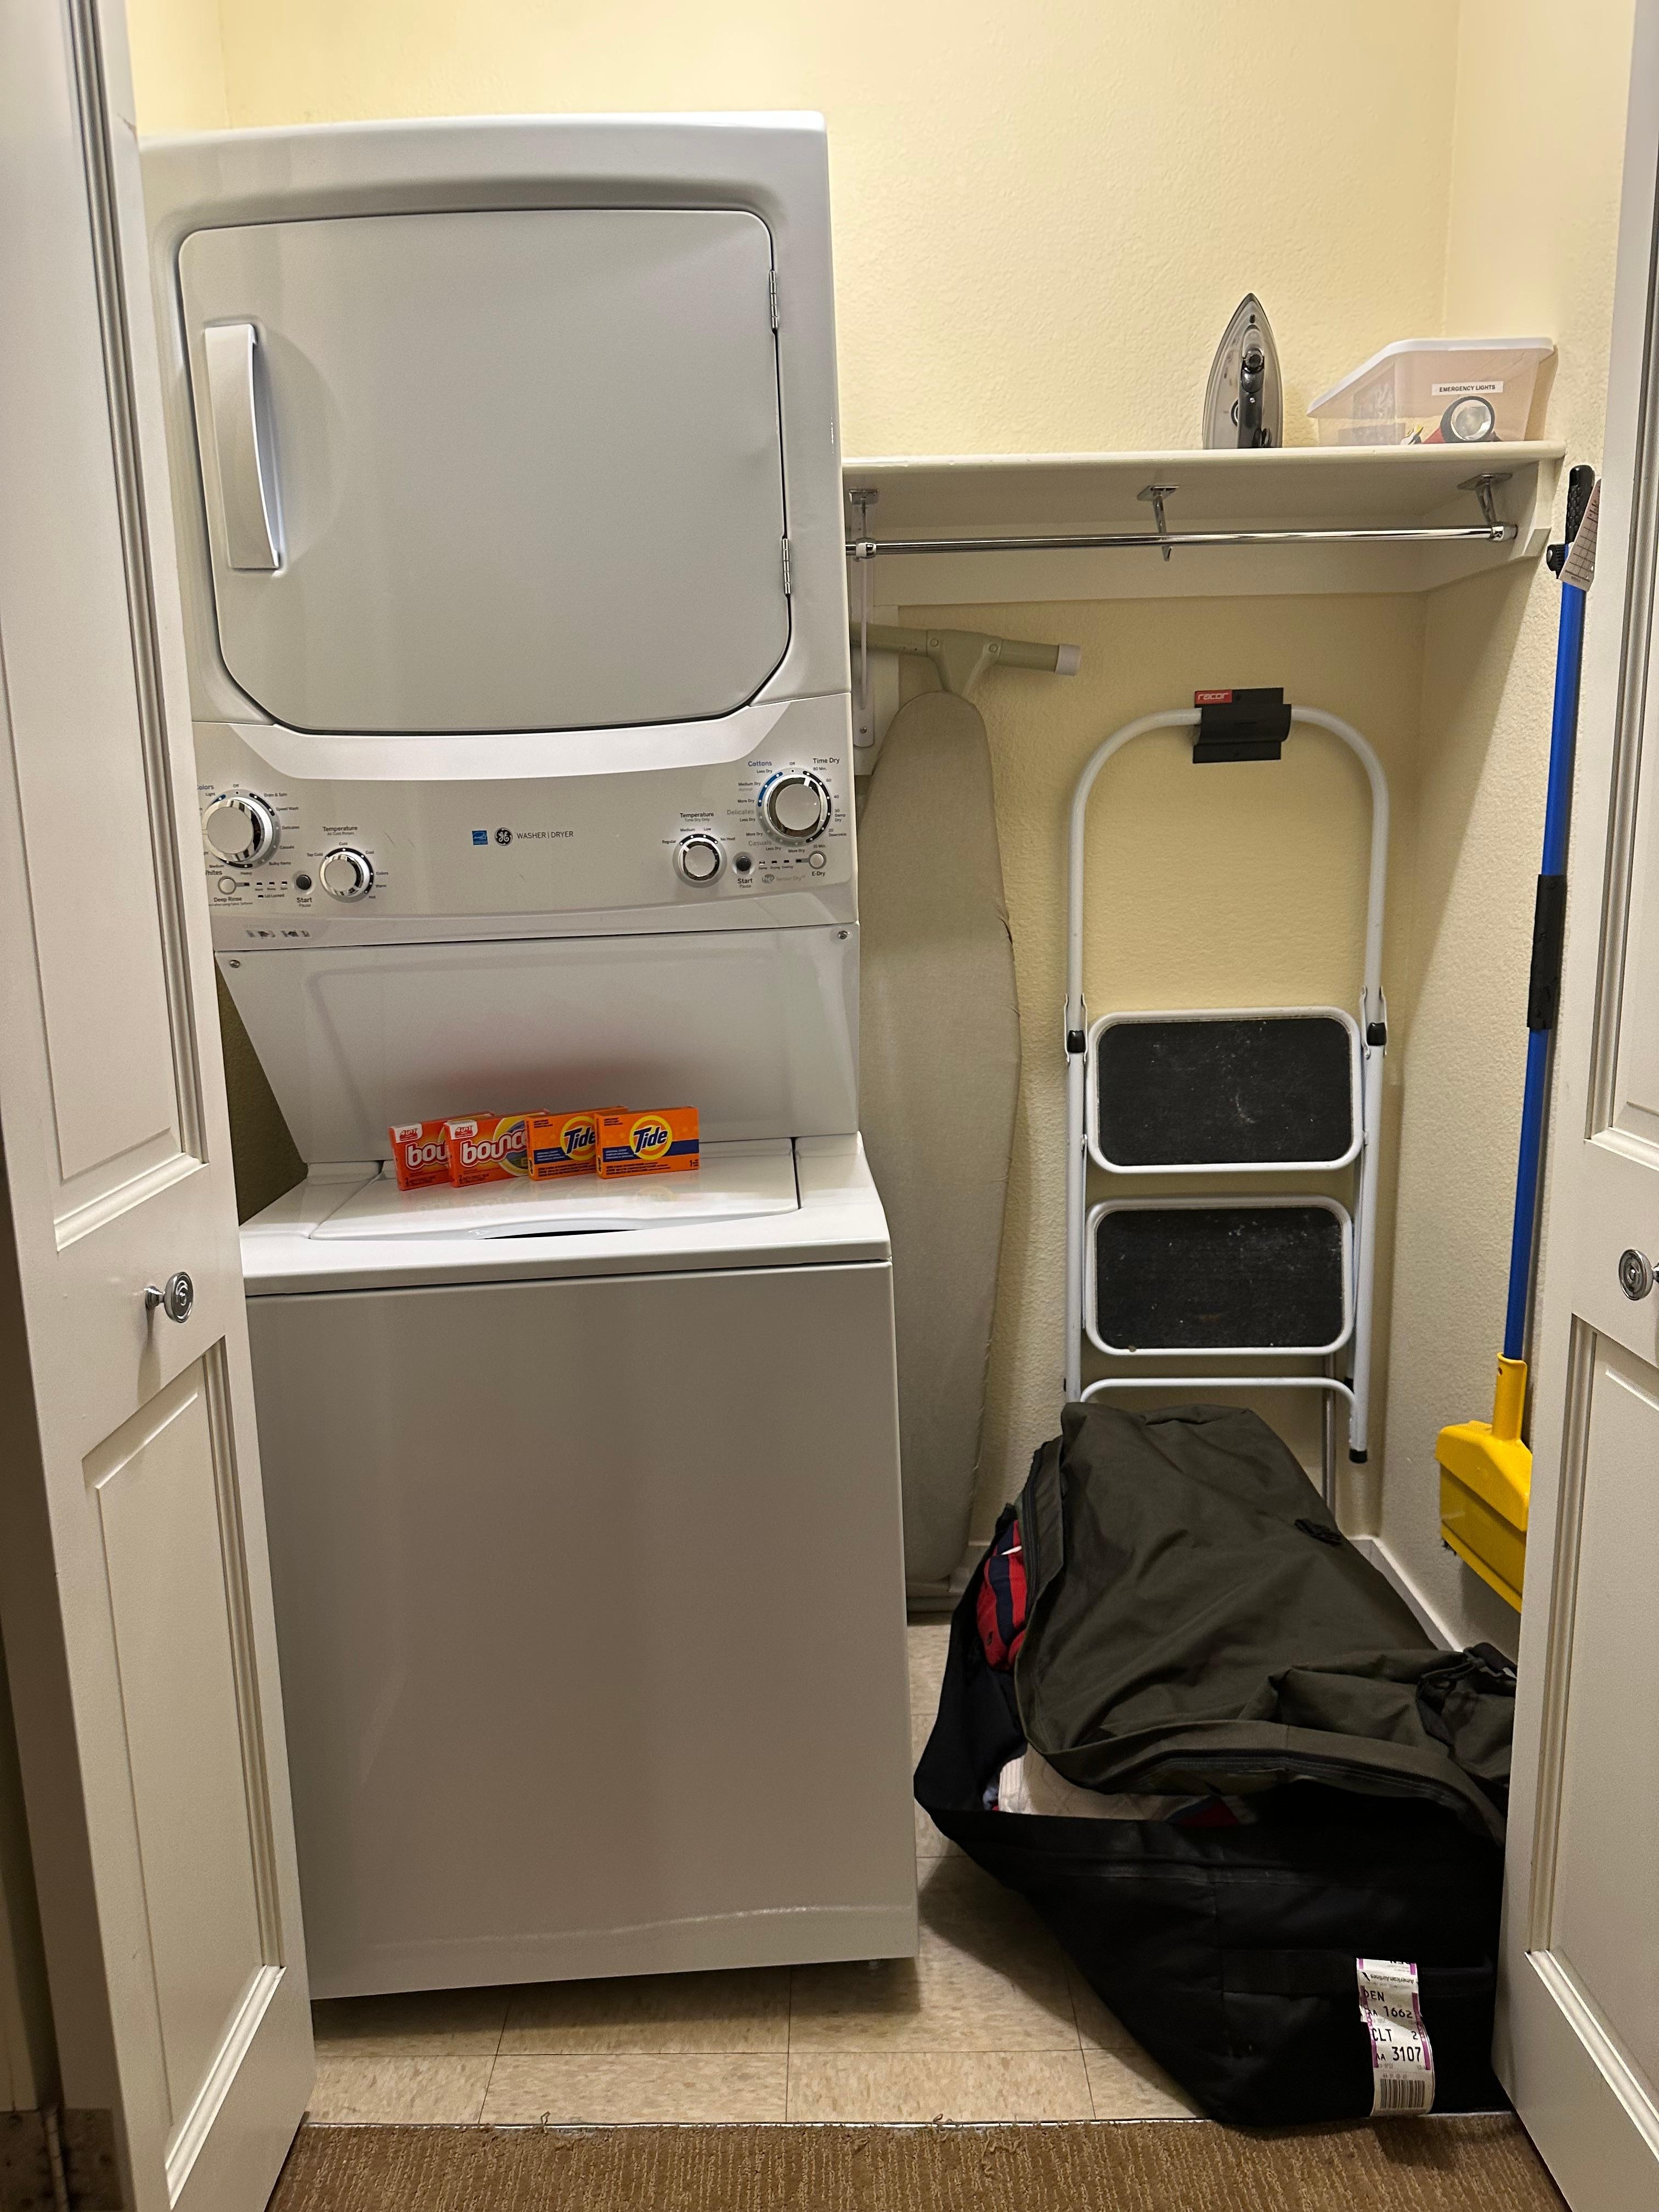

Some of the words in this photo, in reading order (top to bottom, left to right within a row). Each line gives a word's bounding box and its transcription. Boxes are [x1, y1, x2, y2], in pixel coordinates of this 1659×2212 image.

[1198, 692, 1229, 701] racor
[565, 1127, 596, 1155] Tide
[633, 1126, 668, 1153] Tide
[407, 1143, 448, 1168] bou
[461, 1130, 527, 1166] bounc
[1364, 1990, 1385, 2002] DEN
[1383, 2005, 1413, 2018] 1662
[1372, 2028, 1392, 2042] CLT
[1391, 2046, 1421, 2062] 3107
